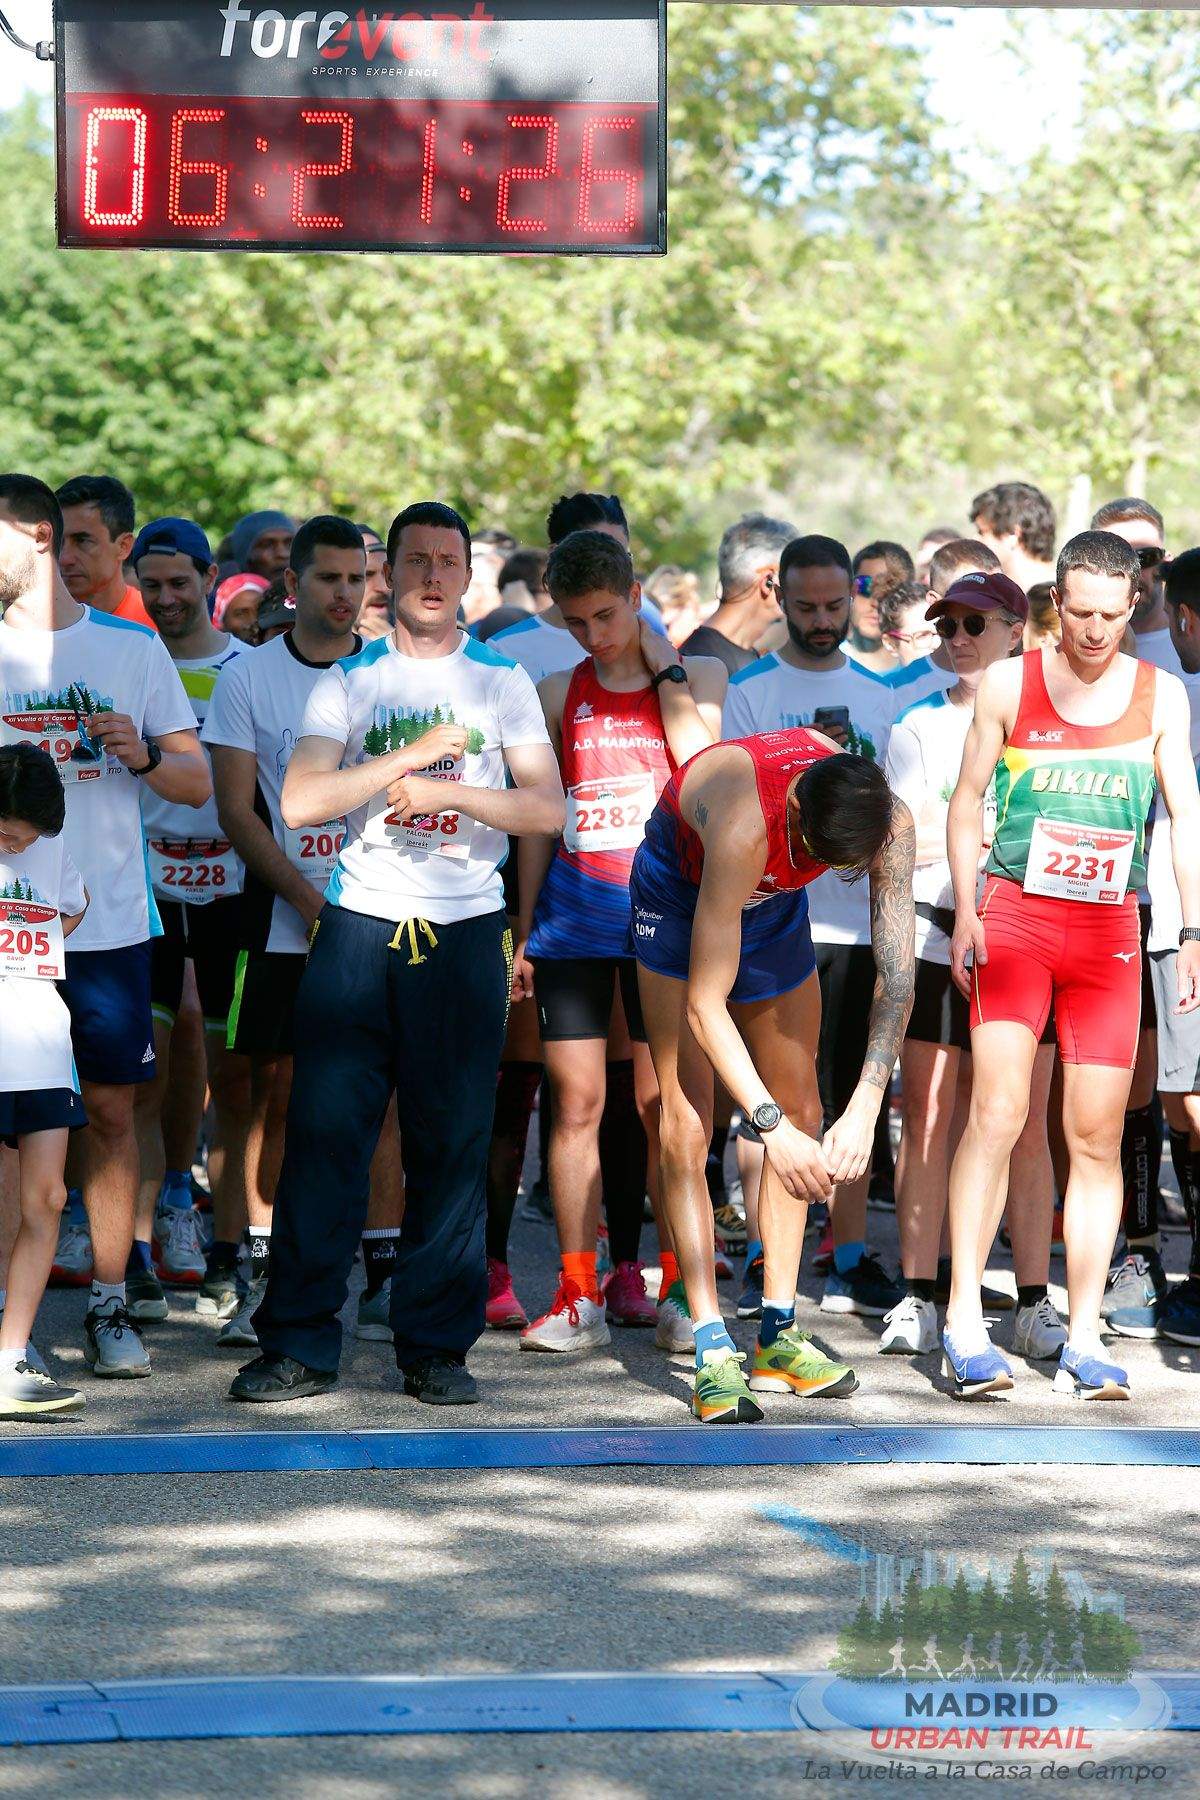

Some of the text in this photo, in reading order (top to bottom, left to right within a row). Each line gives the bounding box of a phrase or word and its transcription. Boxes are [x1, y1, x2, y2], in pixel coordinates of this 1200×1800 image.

[219, 0, 494, 62] forevent
[311, 66, 439, 78] SPORTS EXPERIENCE
[1031, 767, 1130, 800] BIKILA
[575, 804, 643, 833] 2282
[406, 829, 432, 839] PALOMA
[161, 864, 226, 887] 2228
[1043, 850, 1116, 883] 2231
[1067, 879, 1090, 888] MIGUEL
